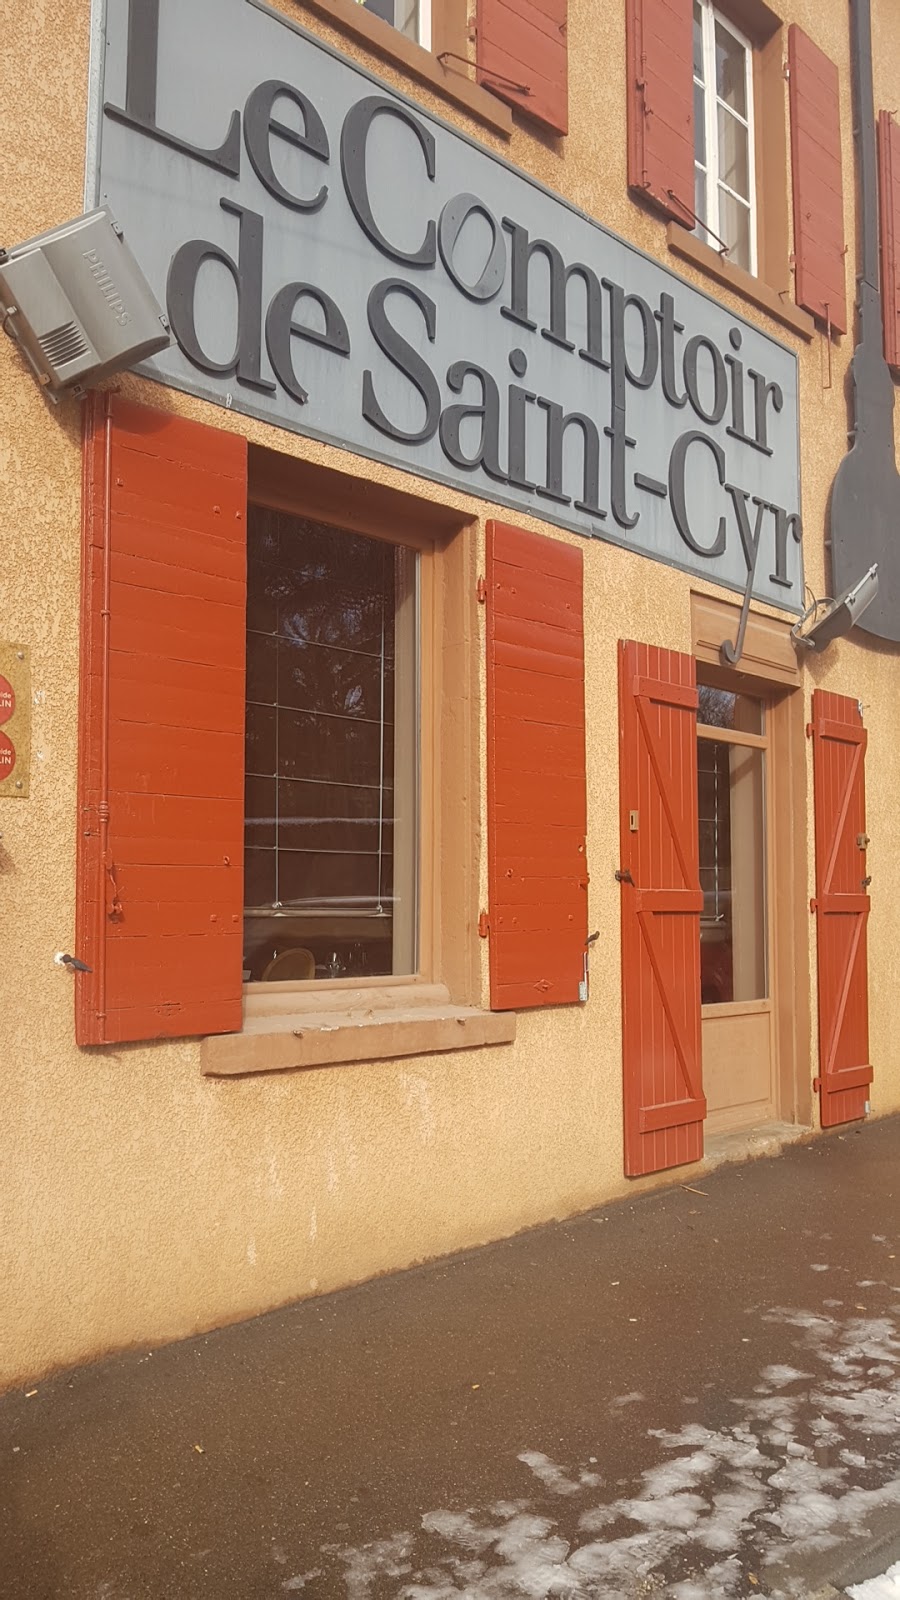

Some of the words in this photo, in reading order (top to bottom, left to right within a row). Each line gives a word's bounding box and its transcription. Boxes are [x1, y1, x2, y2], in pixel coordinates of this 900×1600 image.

[82, 248, 133, 327] PHILIPS
[103, 0, 331, 215] Le
[339, 95, 784, 457] Comptoir
[165, 196, 350, 405] de
[361, 277, 803, 664] Saint-Cyr
